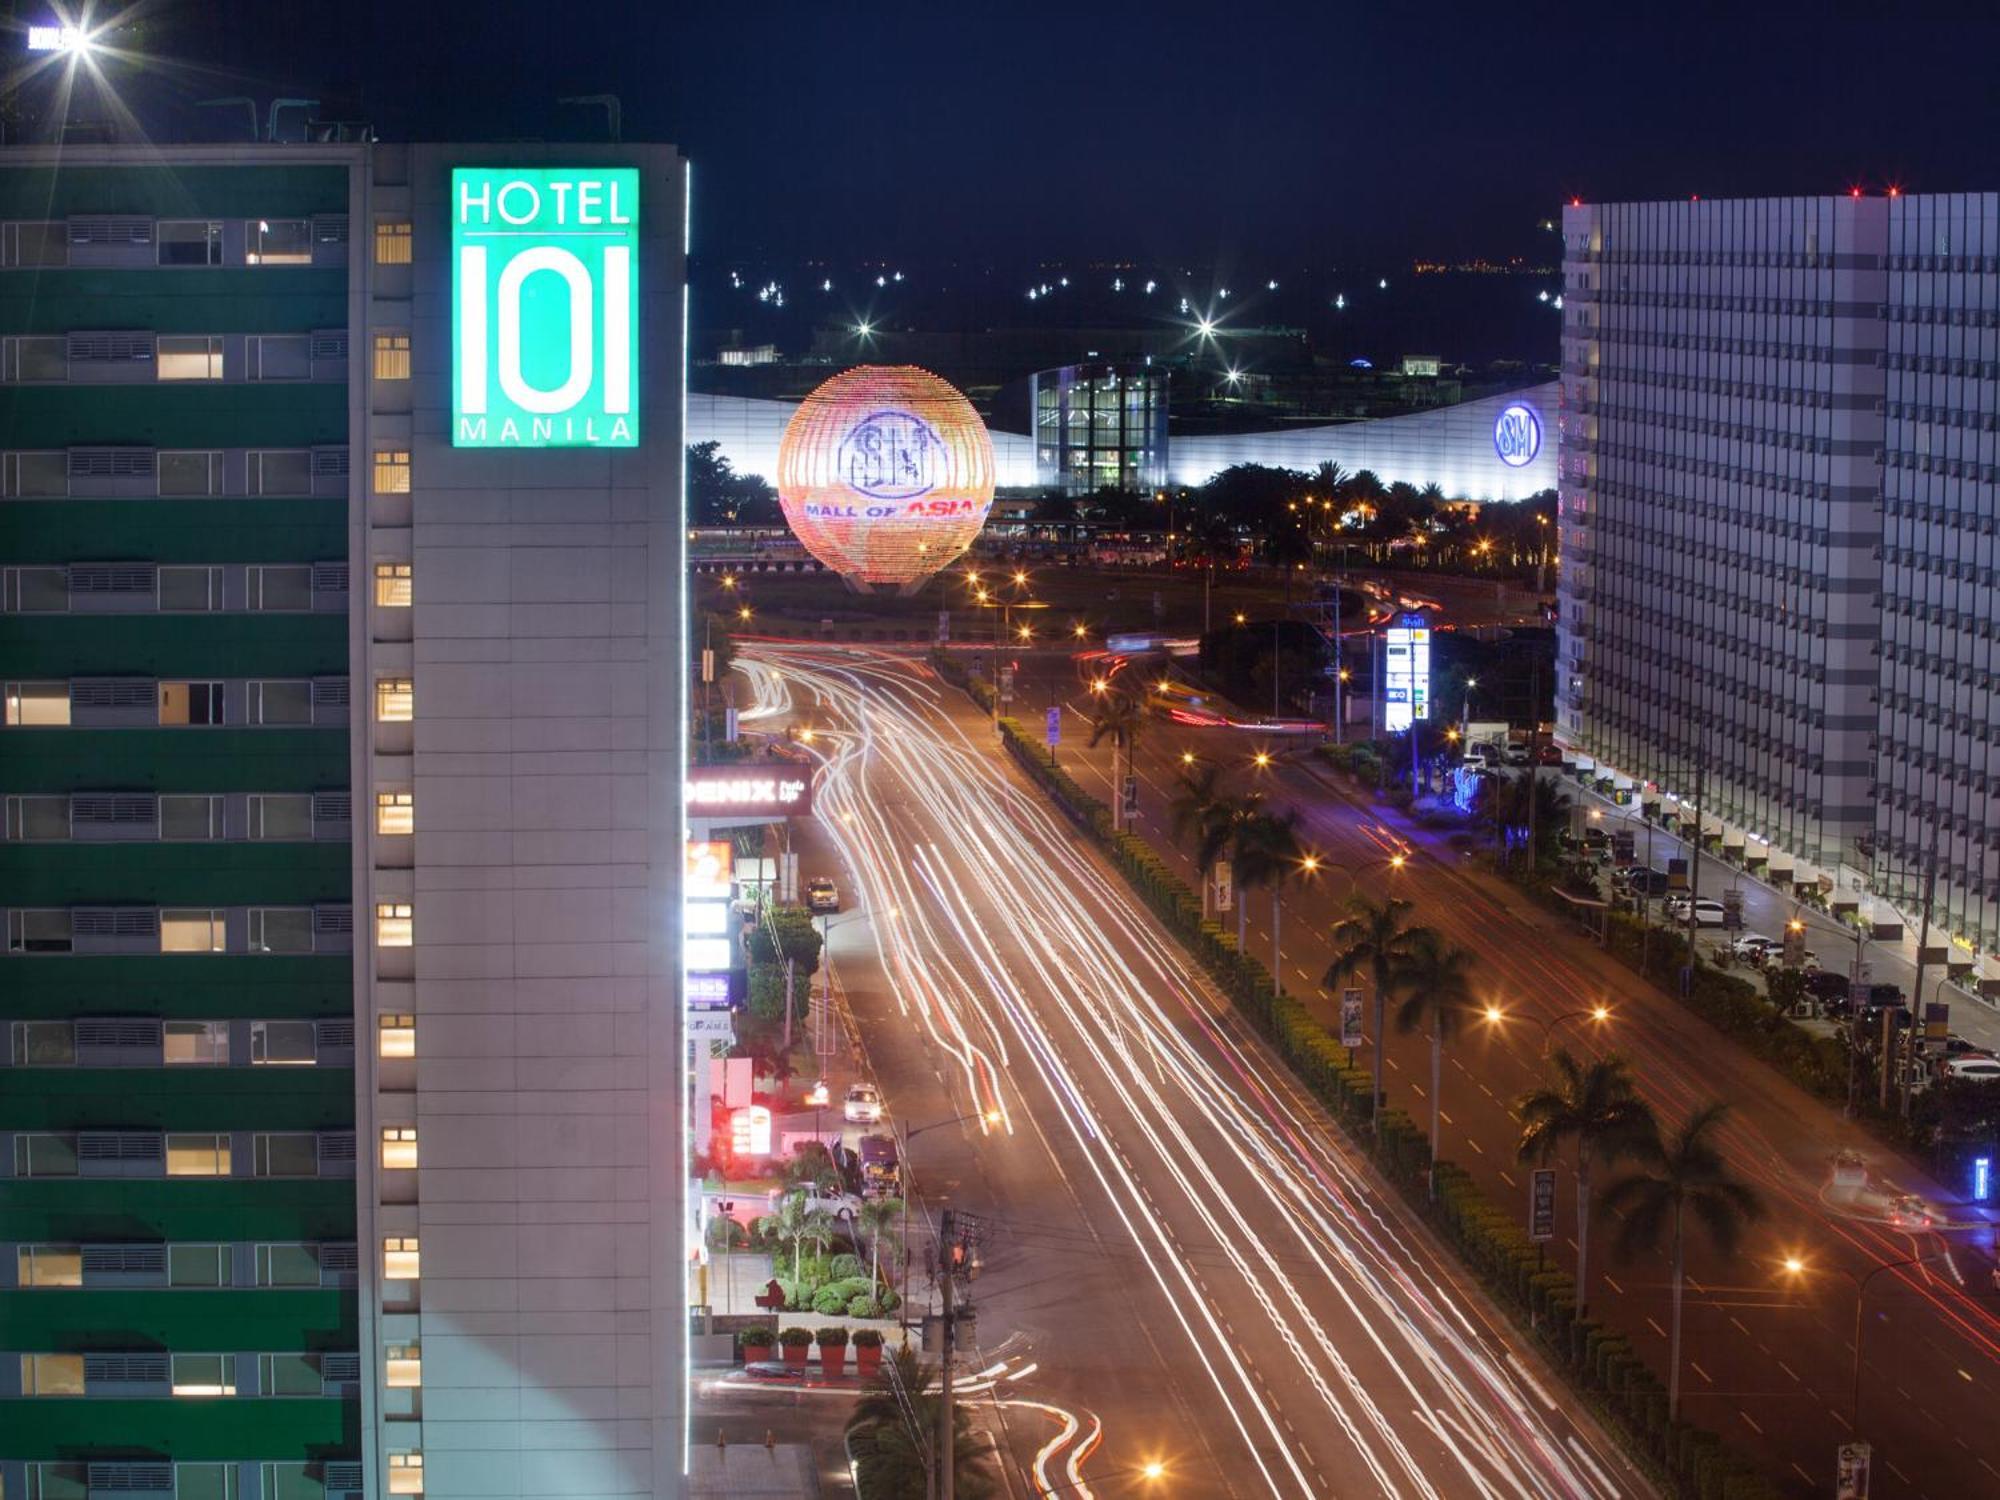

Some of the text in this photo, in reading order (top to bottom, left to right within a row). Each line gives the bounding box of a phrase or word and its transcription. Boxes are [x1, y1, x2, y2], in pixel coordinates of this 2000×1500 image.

[461, 181, 631, 225] HOTEL
[460, 417, 632, 442] MANILA
[1499, 413, 1531, 457] SM
[806, 505, 857, 517] MALL
[866, 507, 897, 517] OF
[908, 500, 973, 517] ASIA
